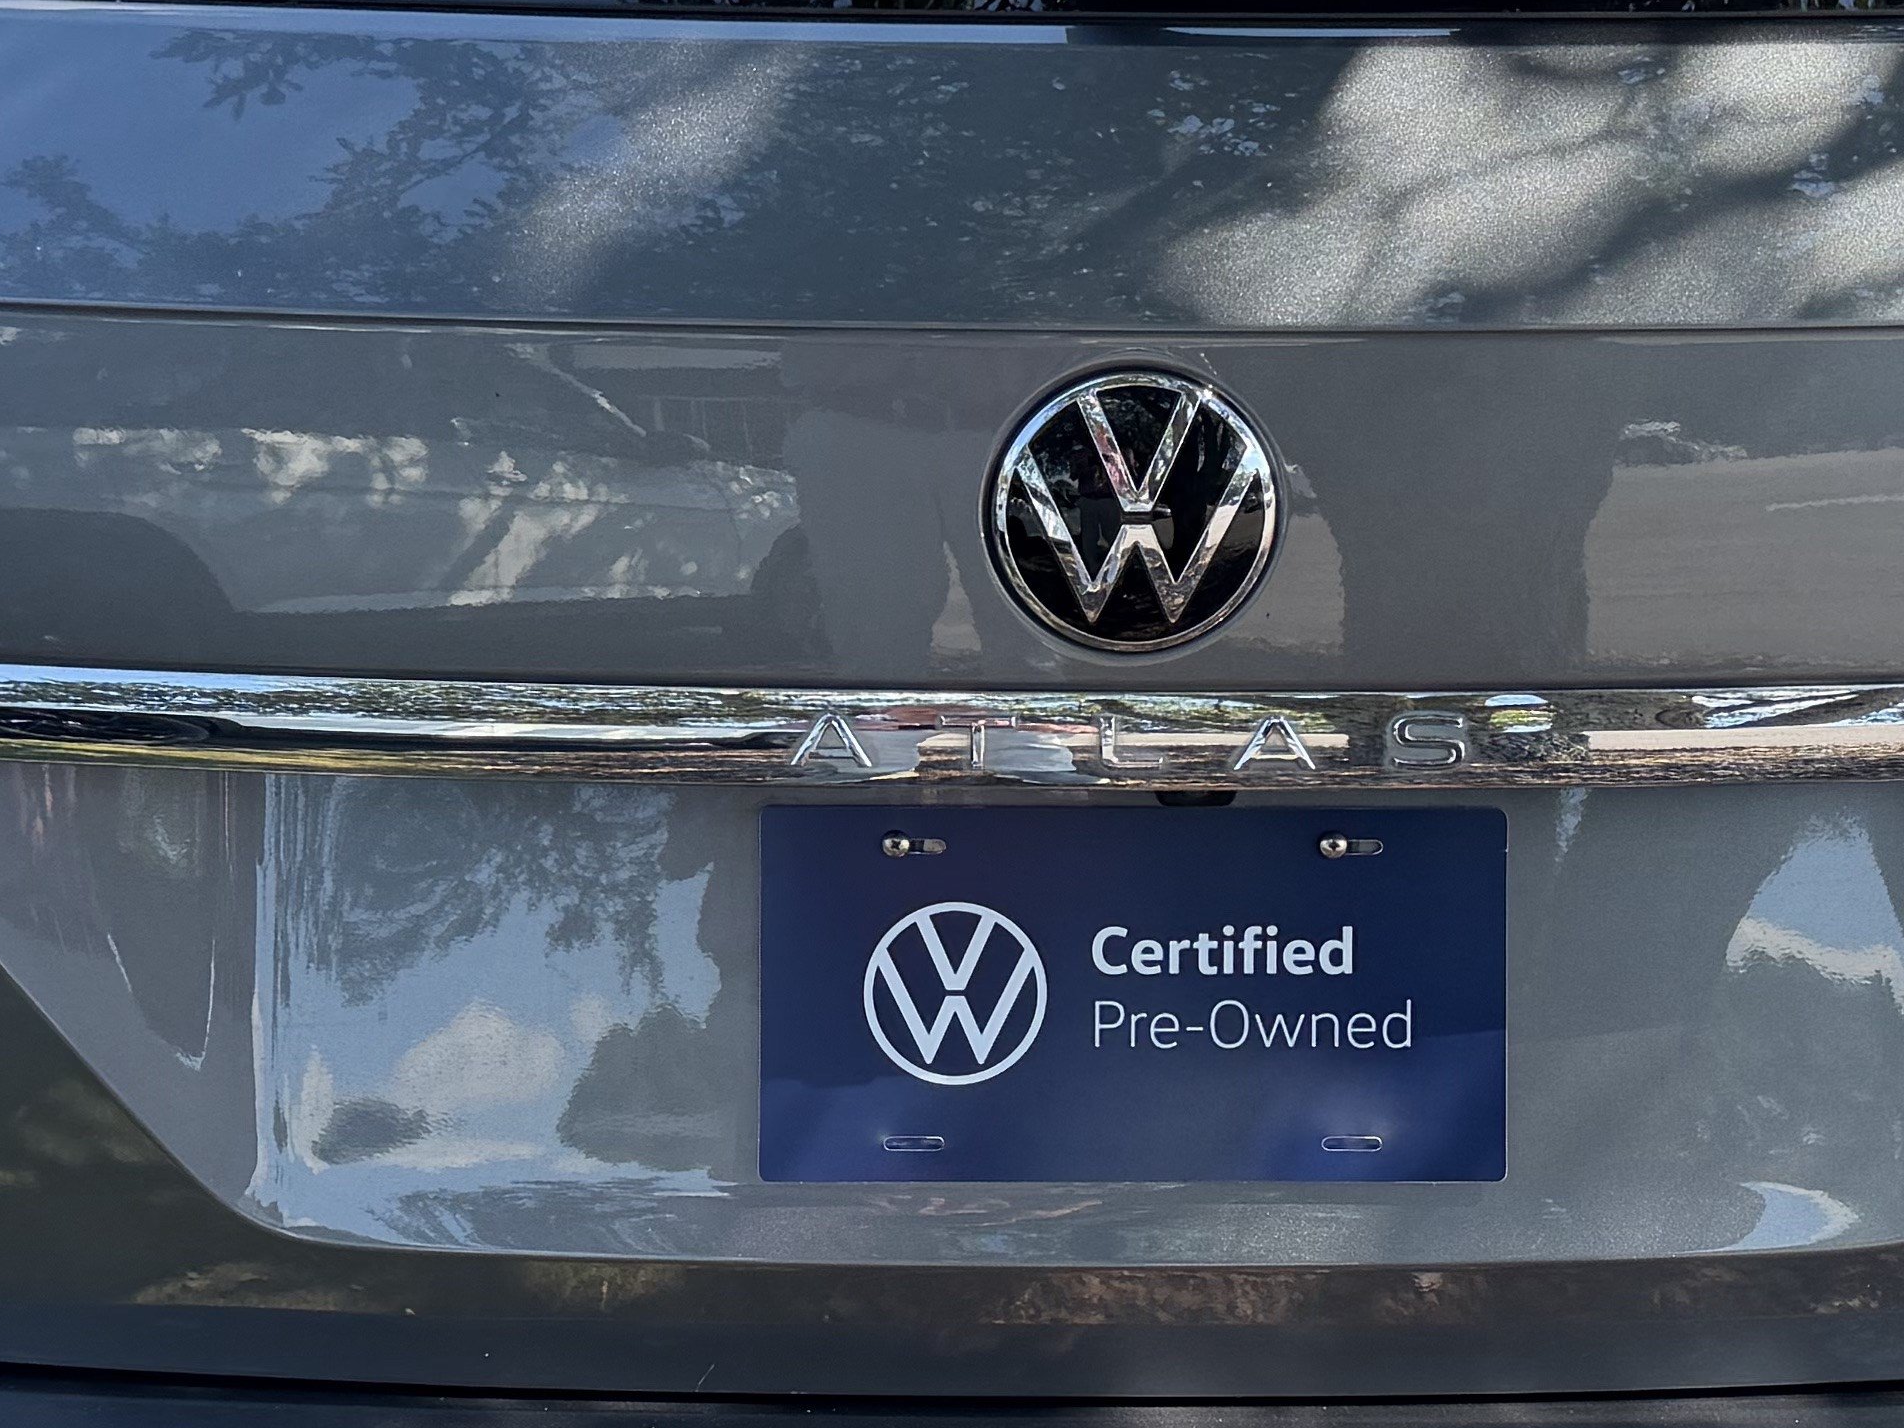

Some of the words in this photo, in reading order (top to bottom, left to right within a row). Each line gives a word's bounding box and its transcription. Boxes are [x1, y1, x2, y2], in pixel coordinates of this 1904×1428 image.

[789, 712, 1469, 772] ATLAS
[1091, 924, 1354, 975] Certified
[1093, 998, 1413, 1050] Pre-Owned
